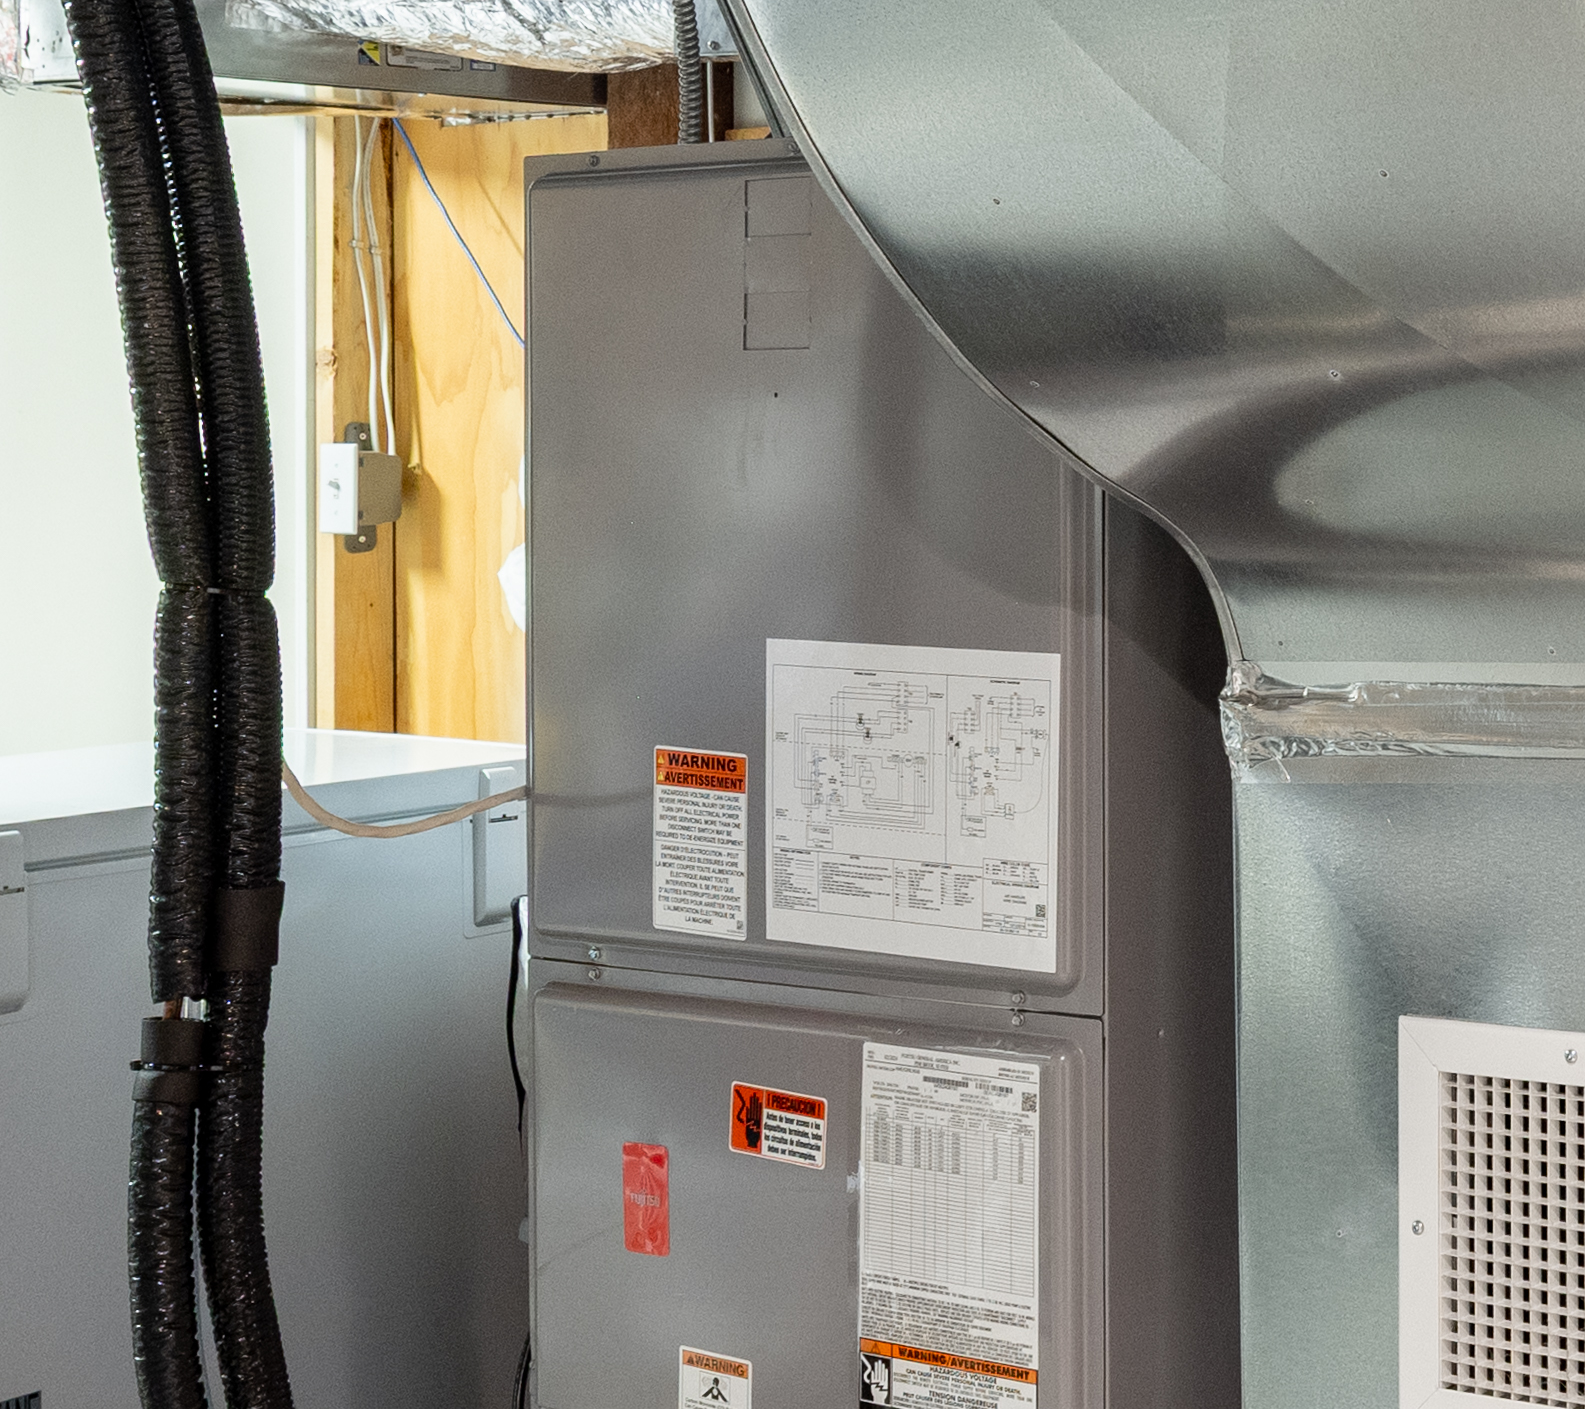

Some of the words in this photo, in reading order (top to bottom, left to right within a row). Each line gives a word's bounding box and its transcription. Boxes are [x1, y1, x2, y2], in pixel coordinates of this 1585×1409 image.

[668, 753, 737, 772] WARNING
[665, 771, 743, 790] AVERTISSEMENT
[695, 1355, 744, 1377] WARNING
[898, 1348, 1030, 1381] WARNING/AVERTISSEMENT
[930, 1366, 968, 1379] HAZARDOUS
[970, 1374, 997, 1384] VOLTAGE
[929, 1390, 956, 1401] TENSION
[958, 1396, 998, 1409] DANGEREUSE
